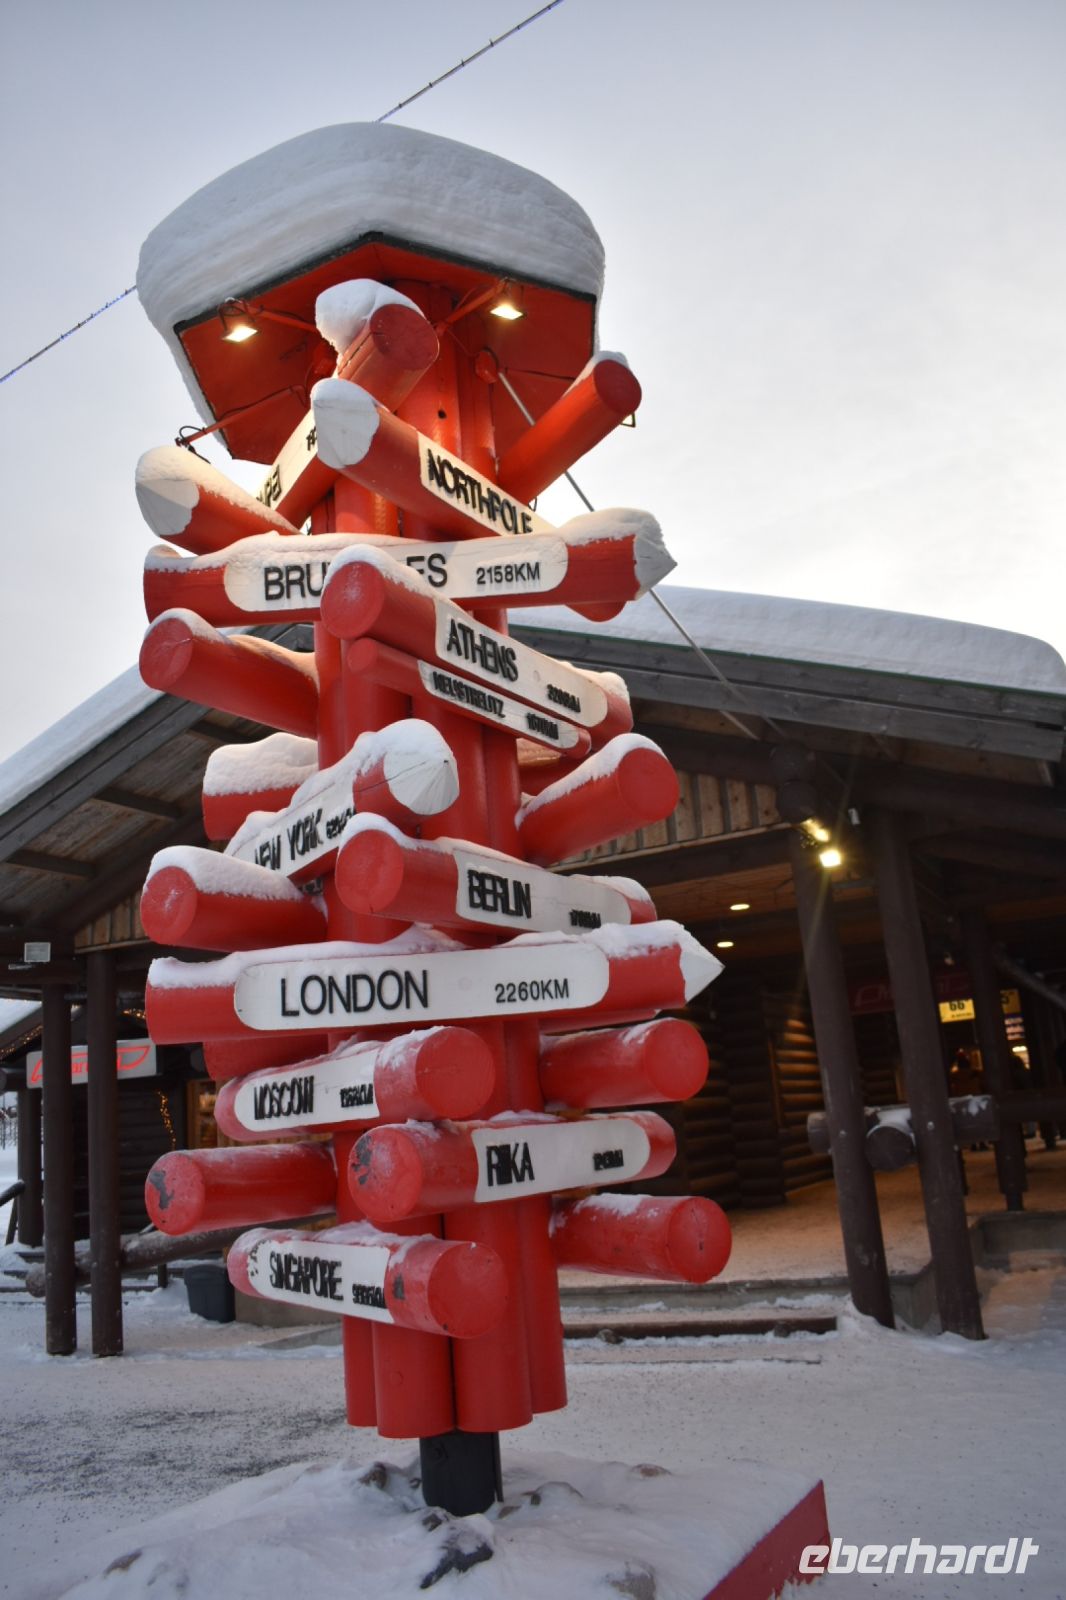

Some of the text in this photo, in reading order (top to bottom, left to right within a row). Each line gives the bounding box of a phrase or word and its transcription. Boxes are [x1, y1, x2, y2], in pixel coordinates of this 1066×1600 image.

[476, 562, 540, 585] 2158KM
[446, 618, 519, 682] ATHENS
[287, 807, 324, 861] YORK
[466, 868, 532, 919] BERLIN
[280, 969, 569, 1017] LONDON 2260KM
[254, 1075, 315, 1121] MOSCOW
[269, 1251, 344, 1301] SINGAPORE
